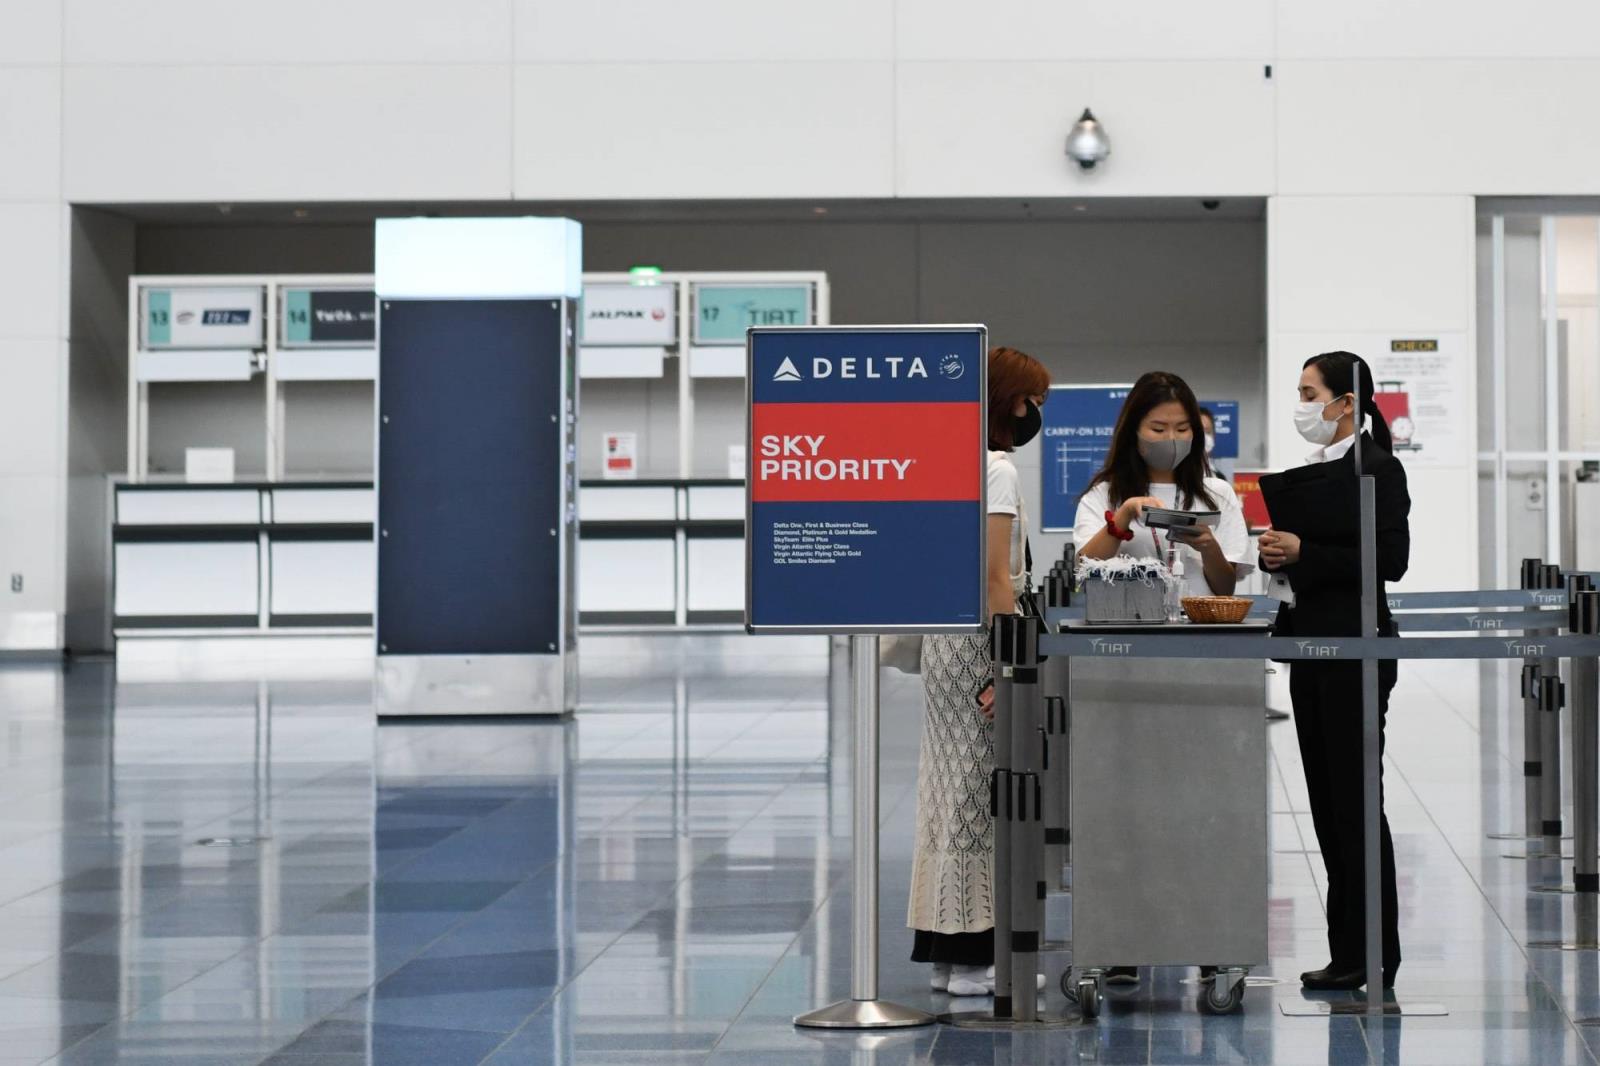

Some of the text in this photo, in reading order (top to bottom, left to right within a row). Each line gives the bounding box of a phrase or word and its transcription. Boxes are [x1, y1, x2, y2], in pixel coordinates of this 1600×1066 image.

[703, 308, 720, 321] 17
[813, 357, 928, 379] DELTA
[1045, 427, 1093, 437] CARRY-ON
[761, 435, 825, 456] SKY
[761, 459, 911, 480] PRIORITY
[1388, 600, 1403, 608] AT
[1474, 619, 1504, 628] TIAT
[1099, 642, 1132, 654] TIAT
[1307, 645, 1340, 657] TIAT
[1514, 645, 1546, 655] TIAT
